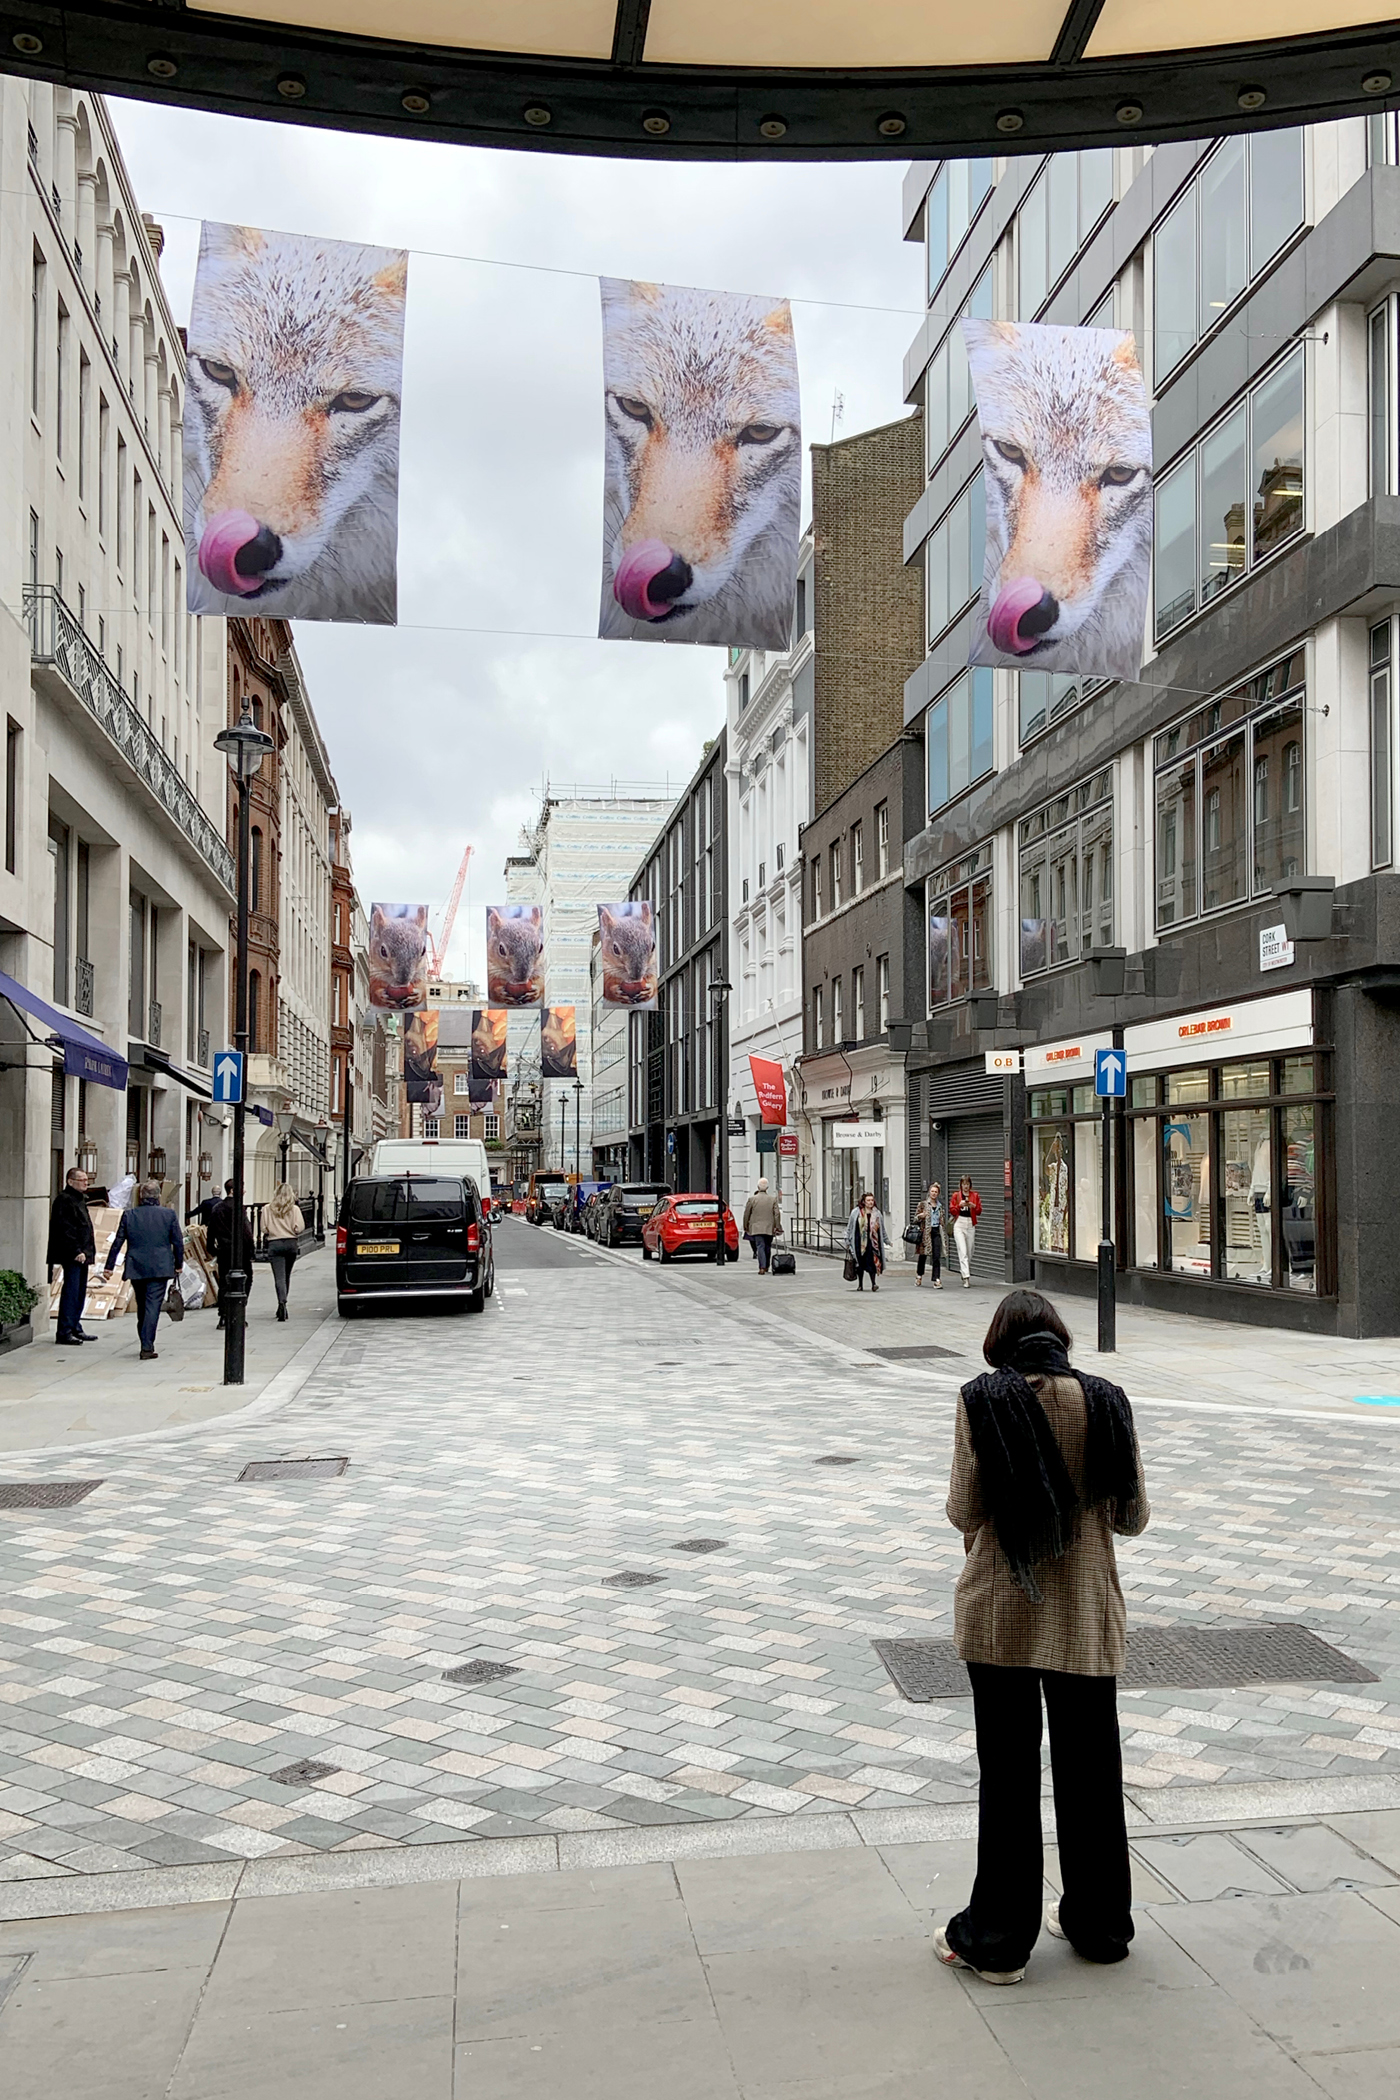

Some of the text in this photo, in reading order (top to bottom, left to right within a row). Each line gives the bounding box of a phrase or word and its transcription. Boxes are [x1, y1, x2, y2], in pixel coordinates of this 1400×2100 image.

[1262, 931, 1276, 944] CORK
[1262, 943, 1280, 957] STREET
[1207, 1018, 1231, 1032] BROWN
[762, 1082, 776, 1090] The
[870, 1075, 878, 1093] 19
